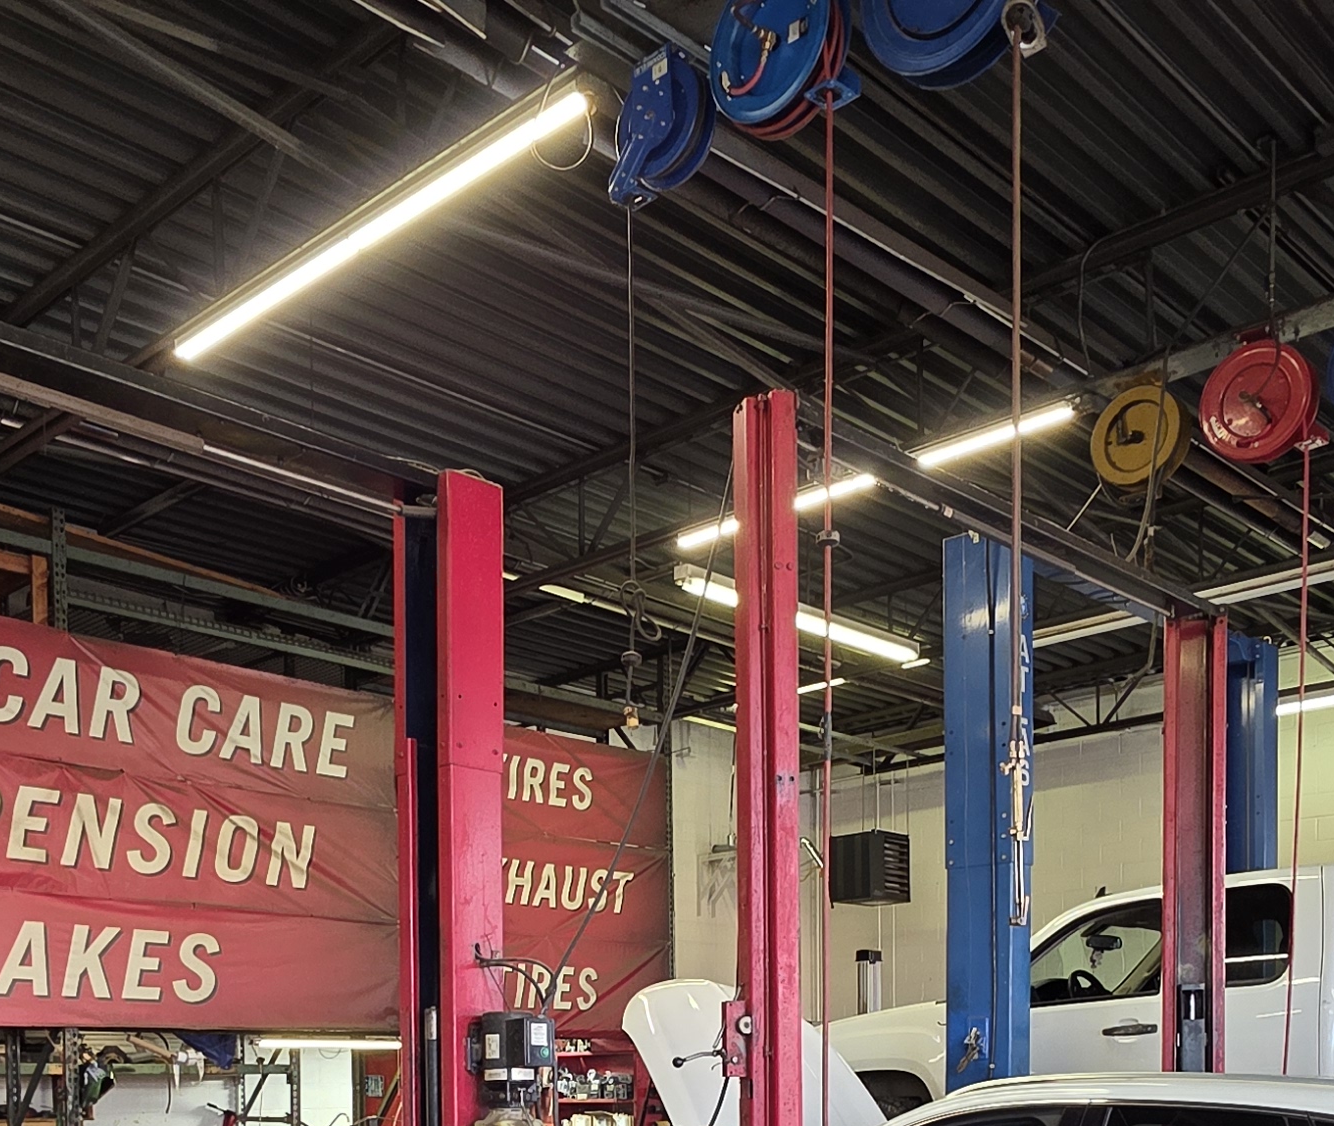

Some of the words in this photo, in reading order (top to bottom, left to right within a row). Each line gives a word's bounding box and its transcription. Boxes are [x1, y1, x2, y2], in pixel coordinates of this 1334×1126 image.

[177, 685, 356, 779] CARE
[502, 753, 594, 811] IRES
[501, 857, 635, 915] HAUST
